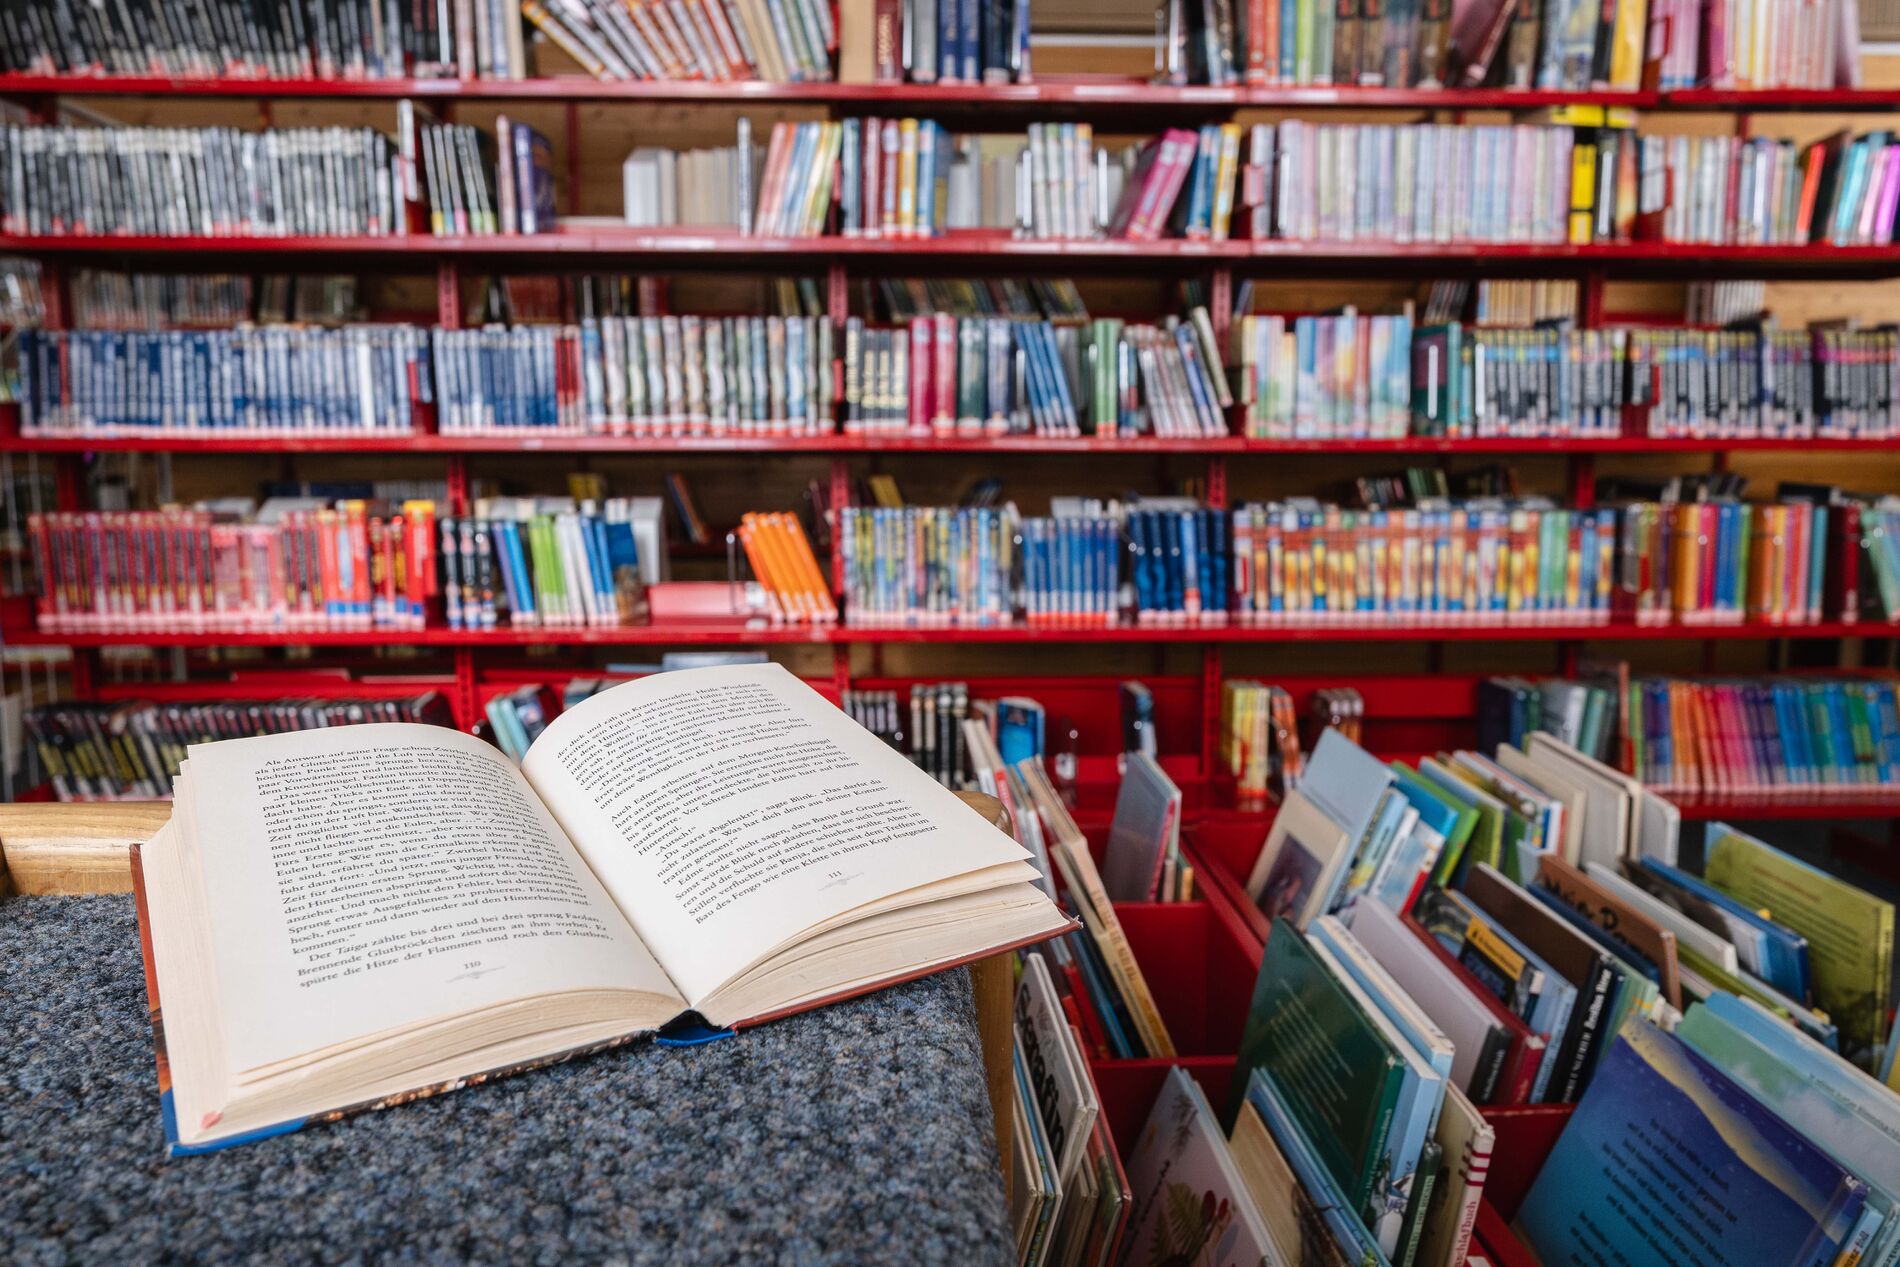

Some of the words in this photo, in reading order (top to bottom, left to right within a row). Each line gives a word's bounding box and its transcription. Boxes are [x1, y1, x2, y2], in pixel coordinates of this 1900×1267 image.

[284, 754, 325, 763] Antwort
[433, 747, 469, 755] Zwirbel
[285, 777, 360, 791] Knochenhügel.
[612, 805, 632, 822] Auch
[634, 789, 658, 804] Edme
[661, 771, 697, 789] arbeitete
[700, 763, 714, 772] auf
[717, 758, 736, 766] dem
[738, 739, 830, 760] Morgan-Knochenhügel
[269, 834, 292, 842] Zeit
[297, 824, 348, 837] möglichst
[376, 811, 466, 823] auskundschaftest.
[633, 817, 681, 848] naufstarrte.
[682, 806, 699, 815] Vor
[702, 791, 736, 807] Schreck
[737, 780, 770, 792] landete
[771, 774, 797, 782] Edme
[662, 849, 679, 863] „Du
[681, 833, 706, 848] warst
[765, 801, 788, 811] sagte
[789, 793, 816, 803] Blink.
[820, 787, 842, 796] „Das
[843, 782, 868, 790] darfst
[638, 827, 682, 856] Hinterteil.
[656, 827, 696, 856] „Autsch!“
[663, 866, 693, 885] tration
[694, 837, 738, 865] gerissen?“
[675, 882, 700, 900] Sonst
[701, 864, 730, 882] würde
[730, 851, 756, 865] Blink
[758, 841, 781, 853] noch
[782, 829, 821, 844] glauben,
[821, 822, 842, 830] dass
[855, 813, 874, 821] sich
[872, 806, 912, 816] beschwe-
[678, 867, 704, 885] Edme
[706, 851, 734, 867] wollte
[736, 839, 759, 852] nicht
[761, 829, 790, 841] sagen,
[791, 821, 811, 830] dass
[811, 814, 838, 824] Banja
[855, 802, 885, 812] Grund
[280, 886, 304, 895] fuhr
[308, 879, 336, 888] dann
[339, 873, 364, 882] fort:
[369, 866, 398, 876] „Und
[401, 863, 428, 871] jetzt,
[689, 895, 717, 916] Stillen
[719, 870, 764, 894] verfluchte
[765, 863, 779, 871] sie
[779, 852, 810, 865] Banja,
[811, 844, 826, 853] die
[827, 839, 846, 848] sich
[846, 834, 863, 842] seit
[864, 829, 884, 837] dem
[881, 822, 916, 831] Treffen
[696, 910, 714, 924] Bau
[716, 899, 731, 910] des
[732, 883, 761, 900] Fengo
[762, 874, 780, 884] wie
[781, 865, 800, 876] eine
[800, 854, 830, 867] Klette
[841, 842, 869, 853] ihrem
[868, 834, 892, 845] Kopf
[893, 826, 938, 839] festgesetzt
[828, 870, 842, 879] 111
[284, 905, 306, 914] den
[308, 888, 382, 908] Hinterbeinen
[386, 878, 442, 891] abspringst
[445, 873, 466, 881] und
[519, 870, 578, 883] Vorderbeine
[287, 908, 337, 924] anziehst.
[341, 900, 365, 910] Und
[369, 894, 399, 904] mach
[403, 888, 431, 898] nicht
[457, 880, 494, 888] Fehler,
[289, 920, 331, 934] Sprung
[335, 912, 368, 922] etwas
[374, 896, 448, 913] Ausgefallenes
[470, 888, 525, 897] probieren.
[529, 886, 567, 895] Einfach
[293, 934, 356, 954] kommen.“
[298, 956, 361, 976] Brennende
[368, 935, 455, 957] Glutbröckchen
[461, 926, 506, 937] zischten
[300, 974, 337, 987] spürte
[343, 968, 361, 976] die
[366, 958, 398, 970] Hitze
[404, 952, 422, 960] der
[428, 940, 481, 954] Flammen
[486, 934, 508, 942] und
[513, 931, 538, 939] roch
[566, 930, 613, 940] Glutbrei,
[309, 952, 331, 962] Der
[337, 943, 368, 954] Taiga
[372, 934, 406, 946] zählte
[430, 924, 452, 932] drei
[456, 918, 478, 927] und
[464, 960, 482, 971] 110
